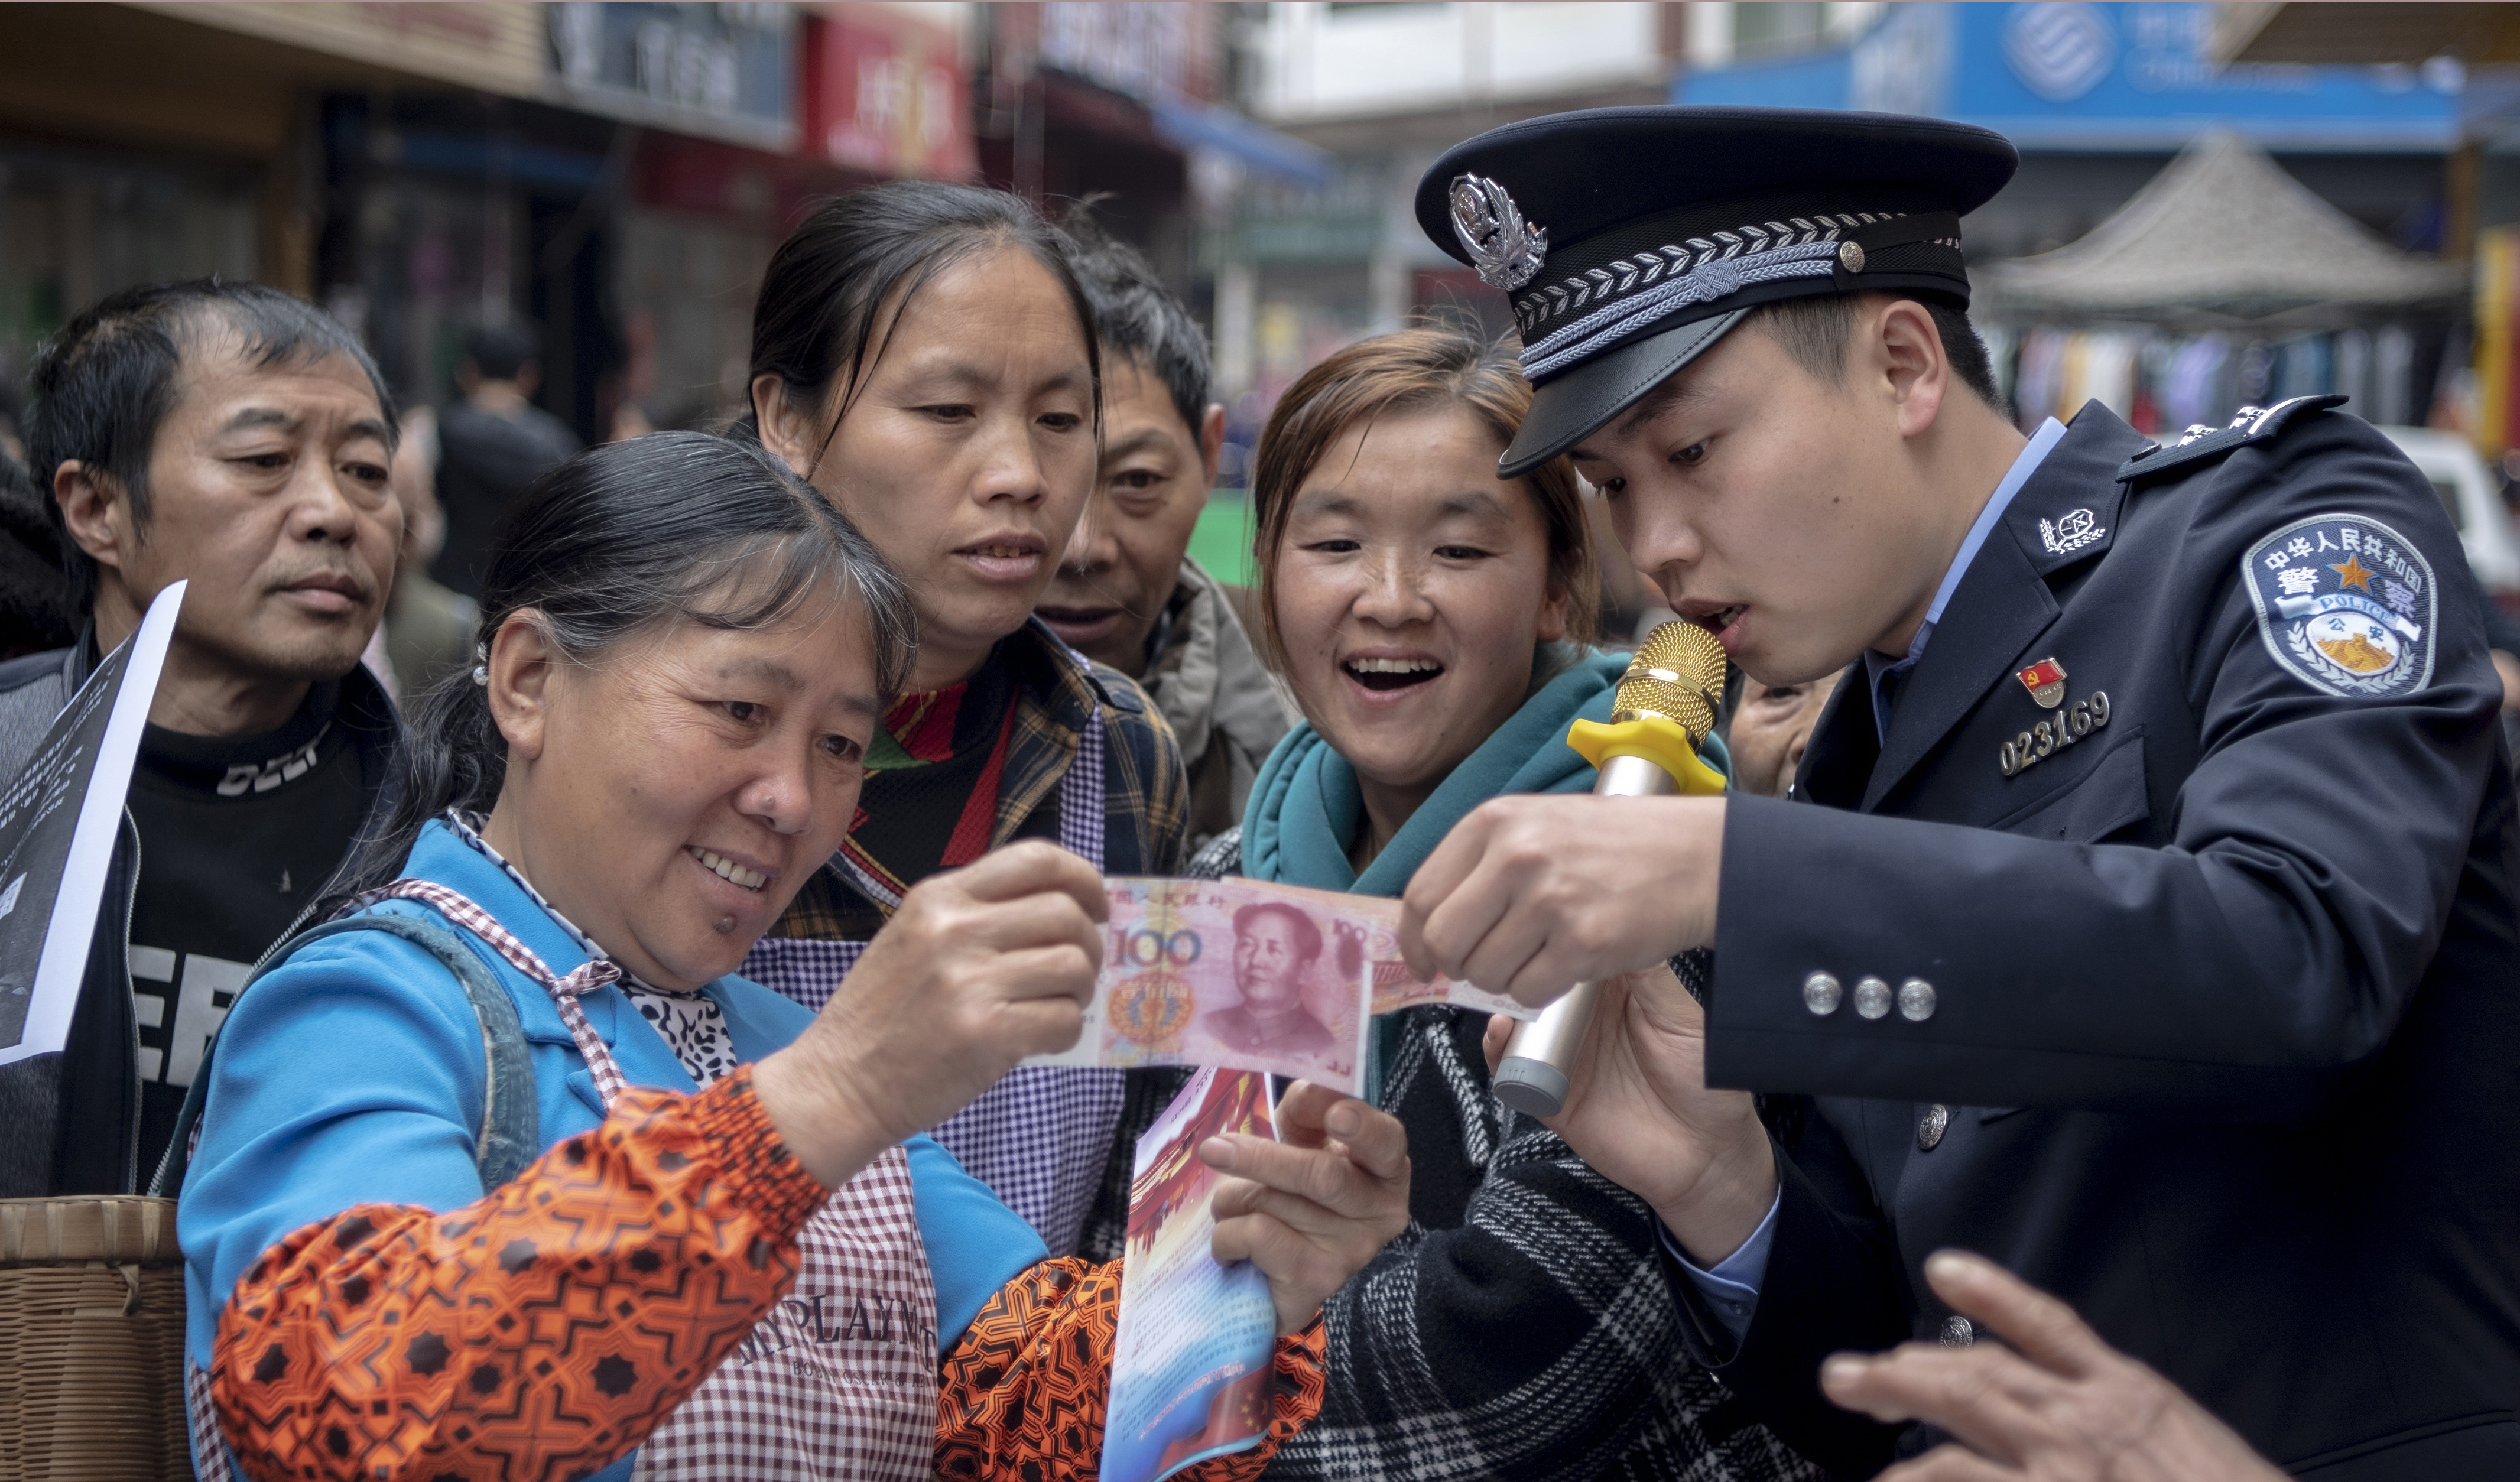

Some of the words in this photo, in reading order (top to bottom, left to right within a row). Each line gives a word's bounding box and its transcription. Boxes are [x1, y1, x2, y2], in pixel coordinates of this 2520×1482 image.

[2264, 528, 2423, 595] 中华人民共和国
[2277, 566, 2320, 594] 警
[2383, 579, 2417, 619] 察
[2319, 593, 2392, 624] POLICE
[2328, 618, 2346, 632] 公
[2368, 625, 2385, 642] 安
[1999, 690, 2110, 776] 023169
[1106, 889, 1223, 911] 国人民银行
[1107, 928, 1203, 968] 100
